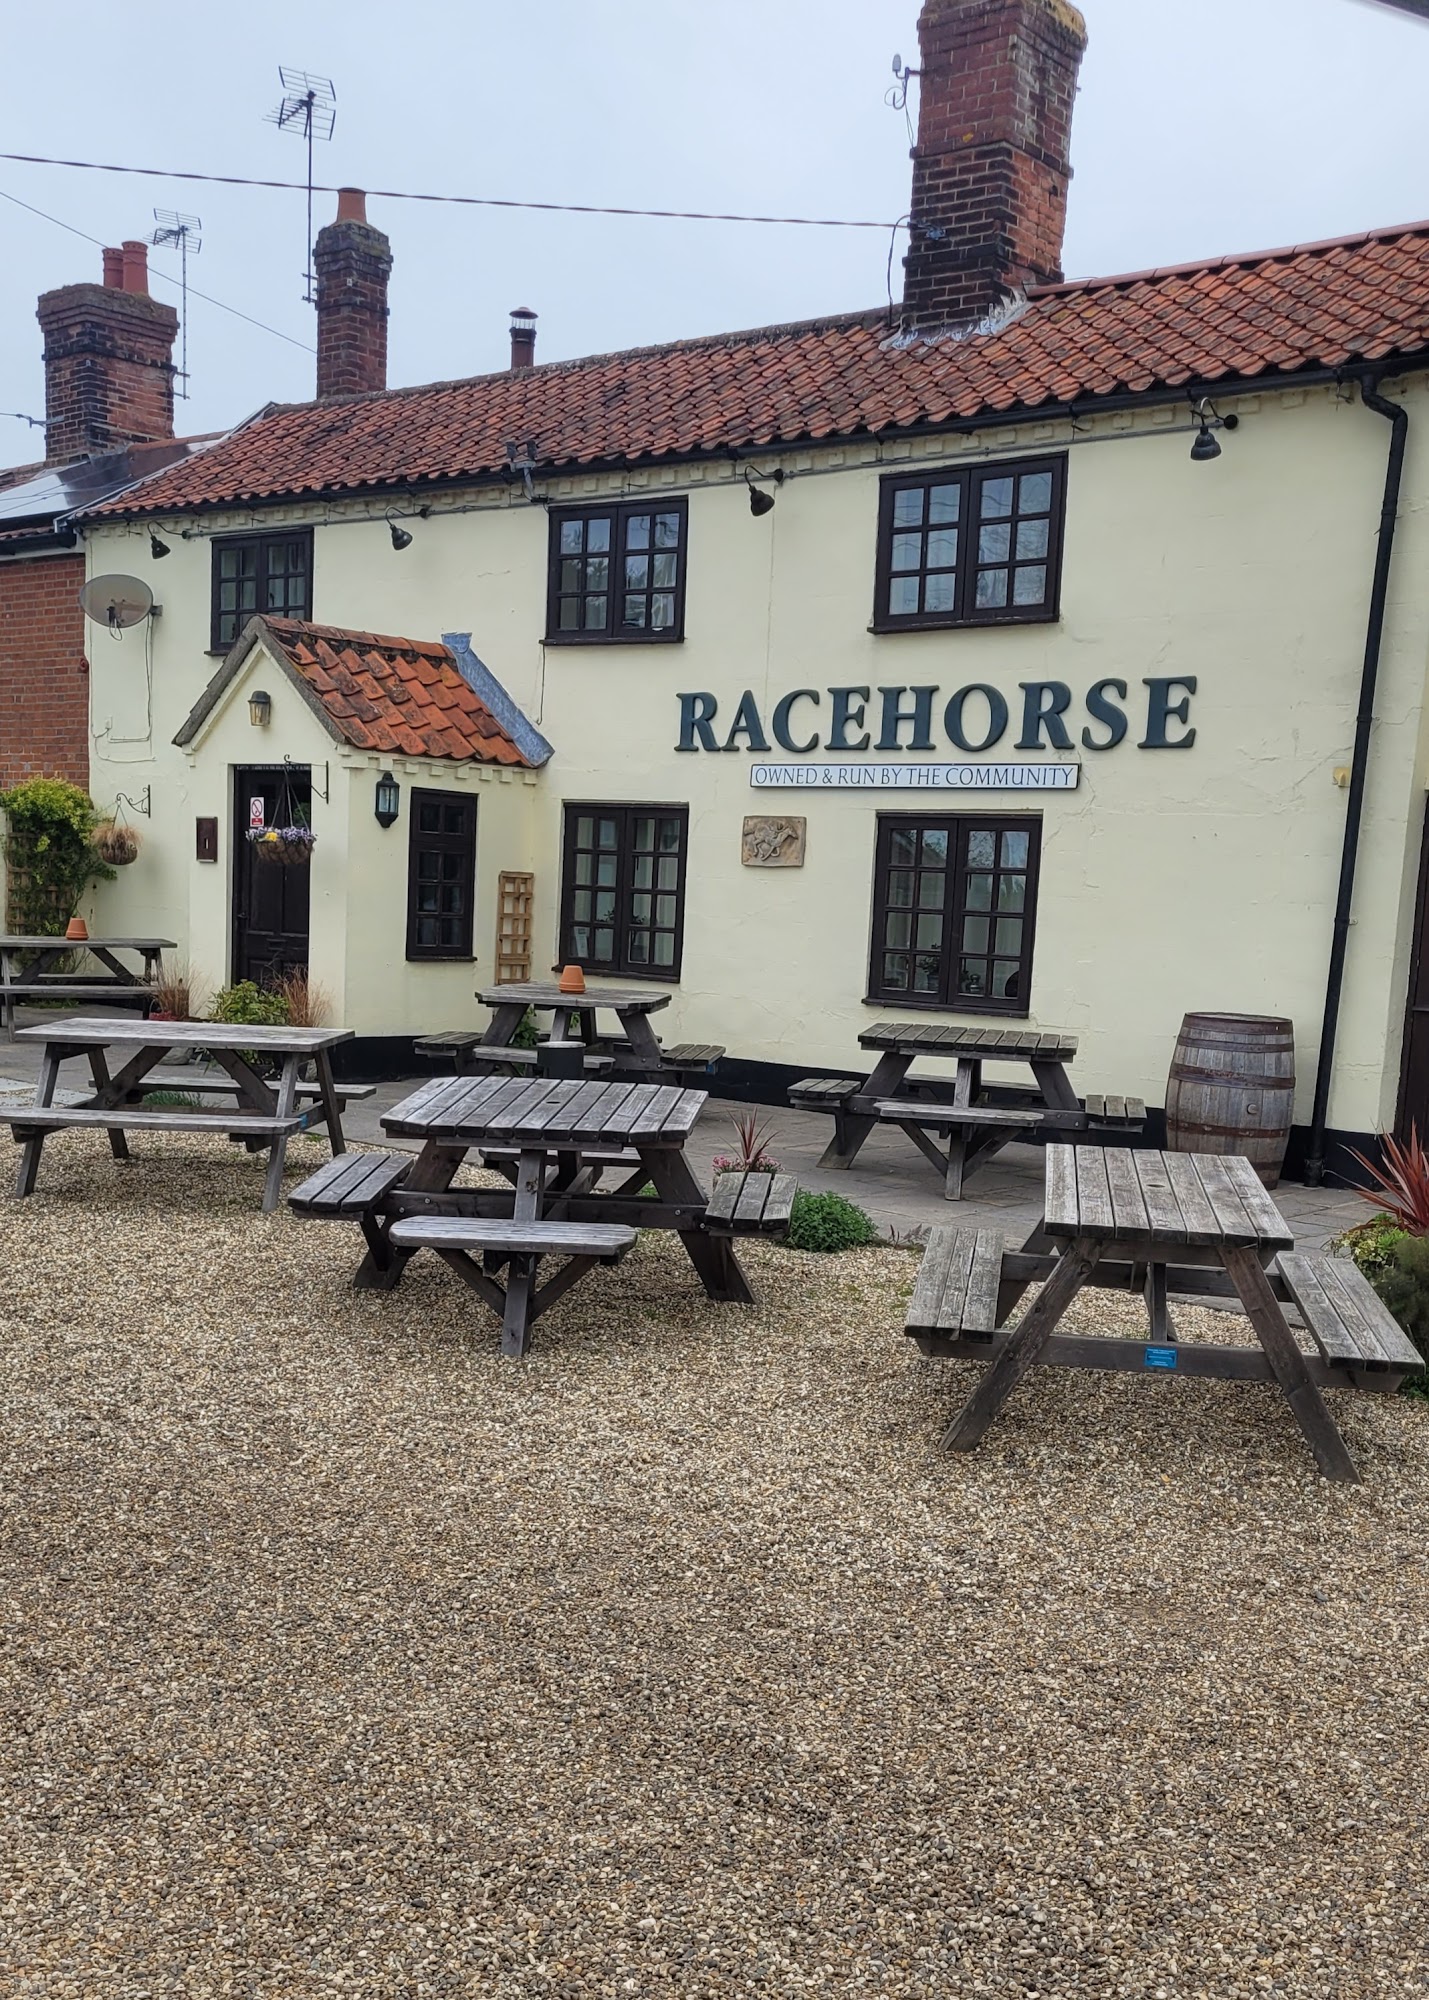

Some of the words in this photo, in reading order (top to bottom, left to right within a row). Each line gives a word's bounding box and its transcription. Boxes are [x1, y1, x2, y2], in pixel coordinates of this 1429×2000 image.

[674, 676, 1198, 752] RACEHORSE
[755, 767, 818, 785] OWNED
[822, 767, 833, 785] &
[838, 767, 876, 785] RUN
[881, 767, 903, 785] BY
[906, 767, 941, 785] THE
[945, 767, 1075, 786] COMMUNITY
